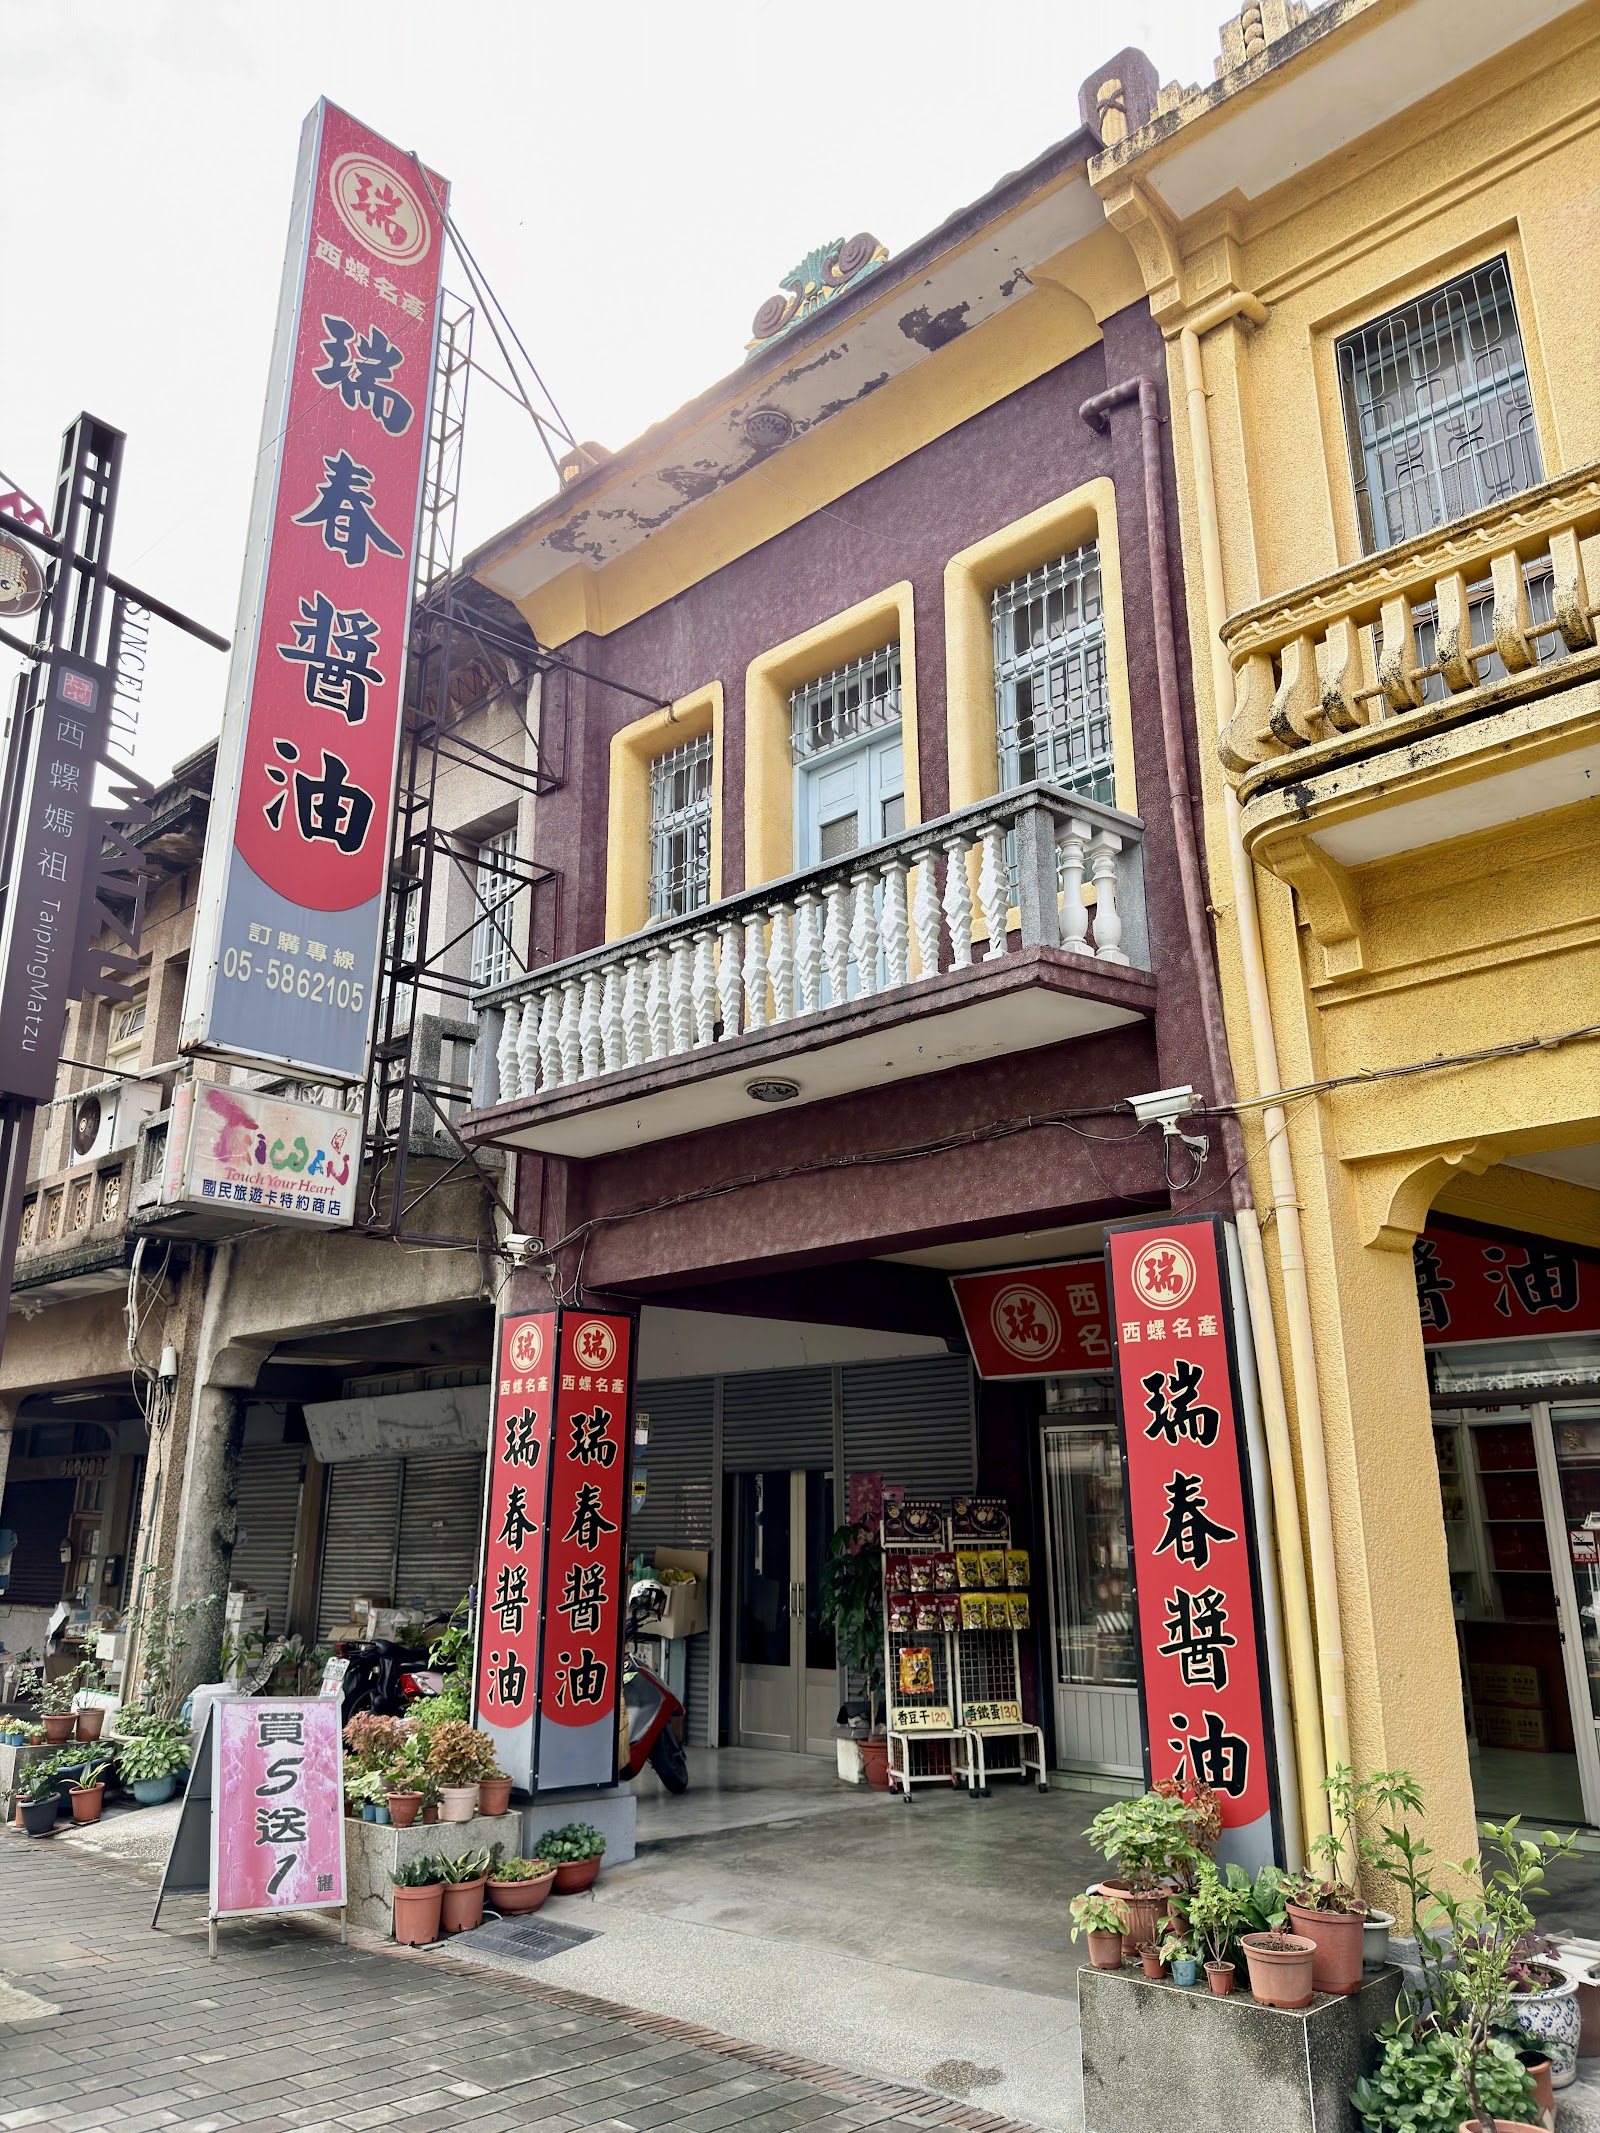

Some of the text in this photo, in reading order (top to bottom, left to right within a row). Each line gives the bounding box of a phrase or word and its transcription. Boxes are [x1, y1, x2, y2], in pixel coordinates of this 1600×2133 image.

[315, 234, 426, 322] 西螺名產
[263, 313, 414, 855] 瑞春醬油
[38, 714, 87, 882] 西螺媽祖
[248, 922, 355, 971] 訂購專線
[223, 947, 365, 1012] 05-5862105
[202, 1178, 342, 1216] 國民旅遊卡特約商店
[224, 1166, 336, 1196] Touch Your Heart
[1144, 1251, 1184, 1295] 瑞
[582, 1328, 608, 1362] 瑞
[1001, 1297, 1048, 1345] 瑞
[1121, 1314, 1219, 1344] 西螺名產
[515, 1330, 537, 1361] 瑞
[500, 1375, 549, 1396] 西螺名產
[562, 1374, 625, 1394] 西螺名產
[487, 1405, 542, 1709] 瑞春醬油
[555, 1404, 619, 1708] 瑞春醬油
[1140, 1357, 1251, 1799] 瑞春醬油
